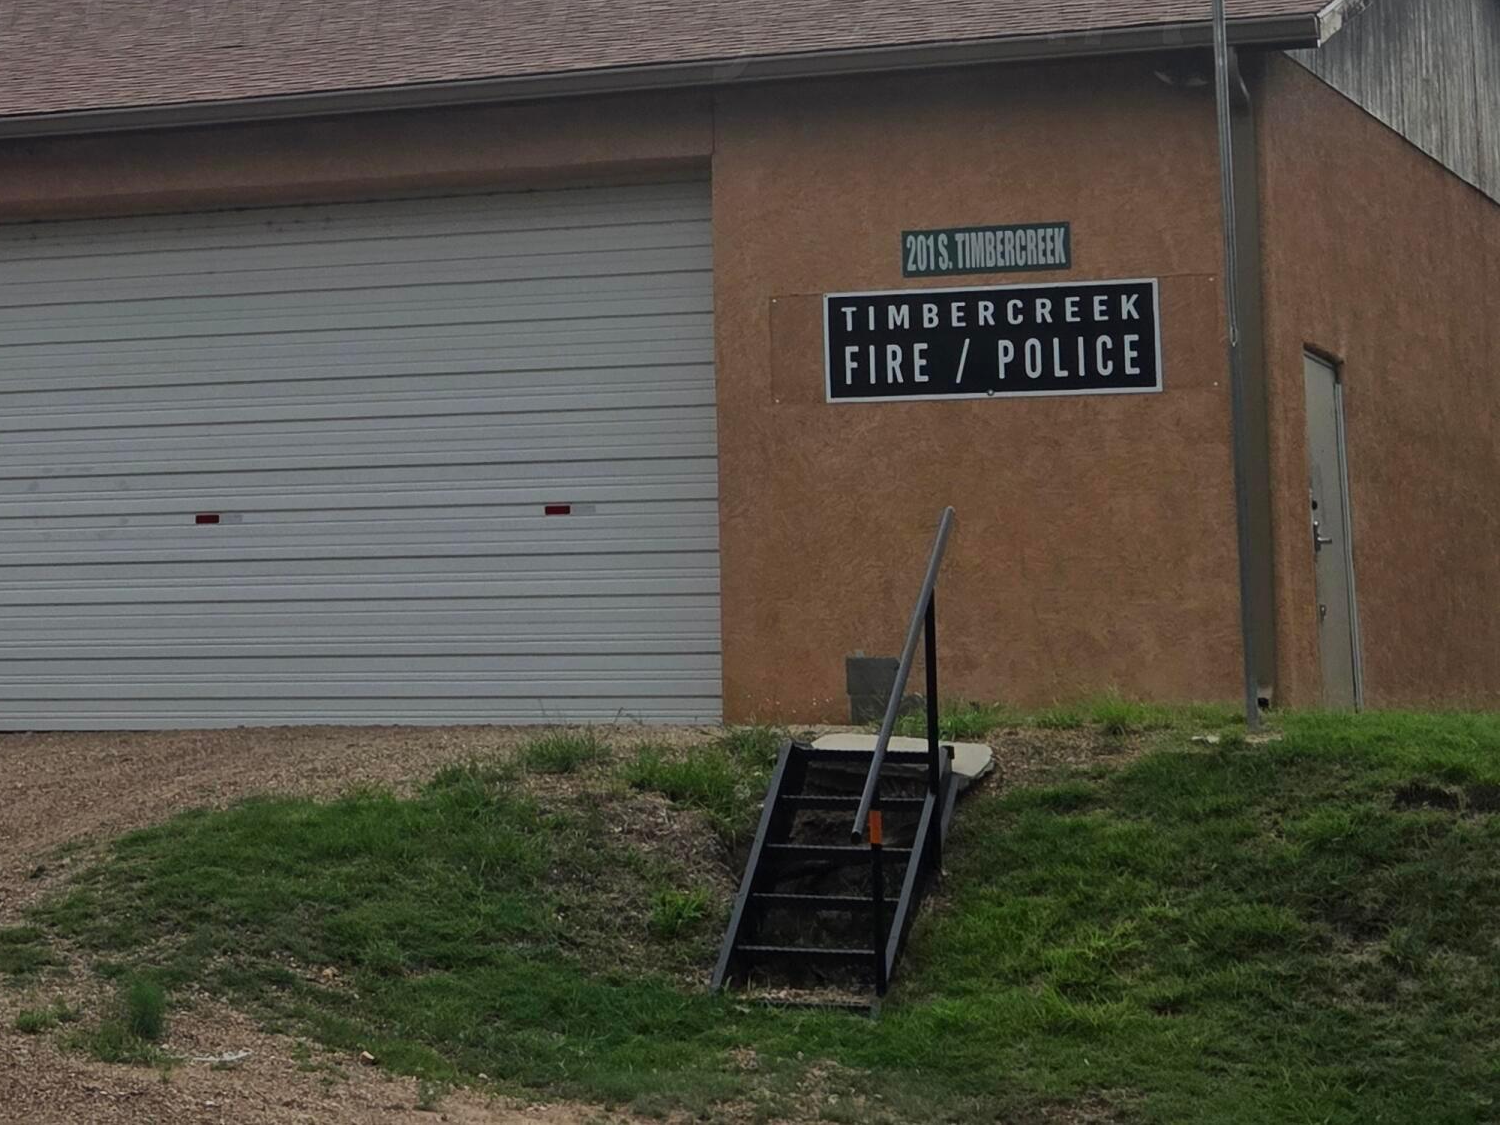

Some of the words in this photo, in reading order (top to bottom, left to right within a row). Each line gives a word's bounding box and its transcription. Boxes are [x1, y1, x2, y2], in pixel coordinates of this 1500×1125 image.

[906, 235, 935, 272] 201
[938, 233, 953, 270] S.
[955, 227, 1067, 269] TIMBERCREEK
[841, 293, 1141, 332] TIMBERCREEK
[844, 342, 930, 385] FIRE
[955, 338, 970, 384] /
[998, 334, 1141, 380] POLICE
